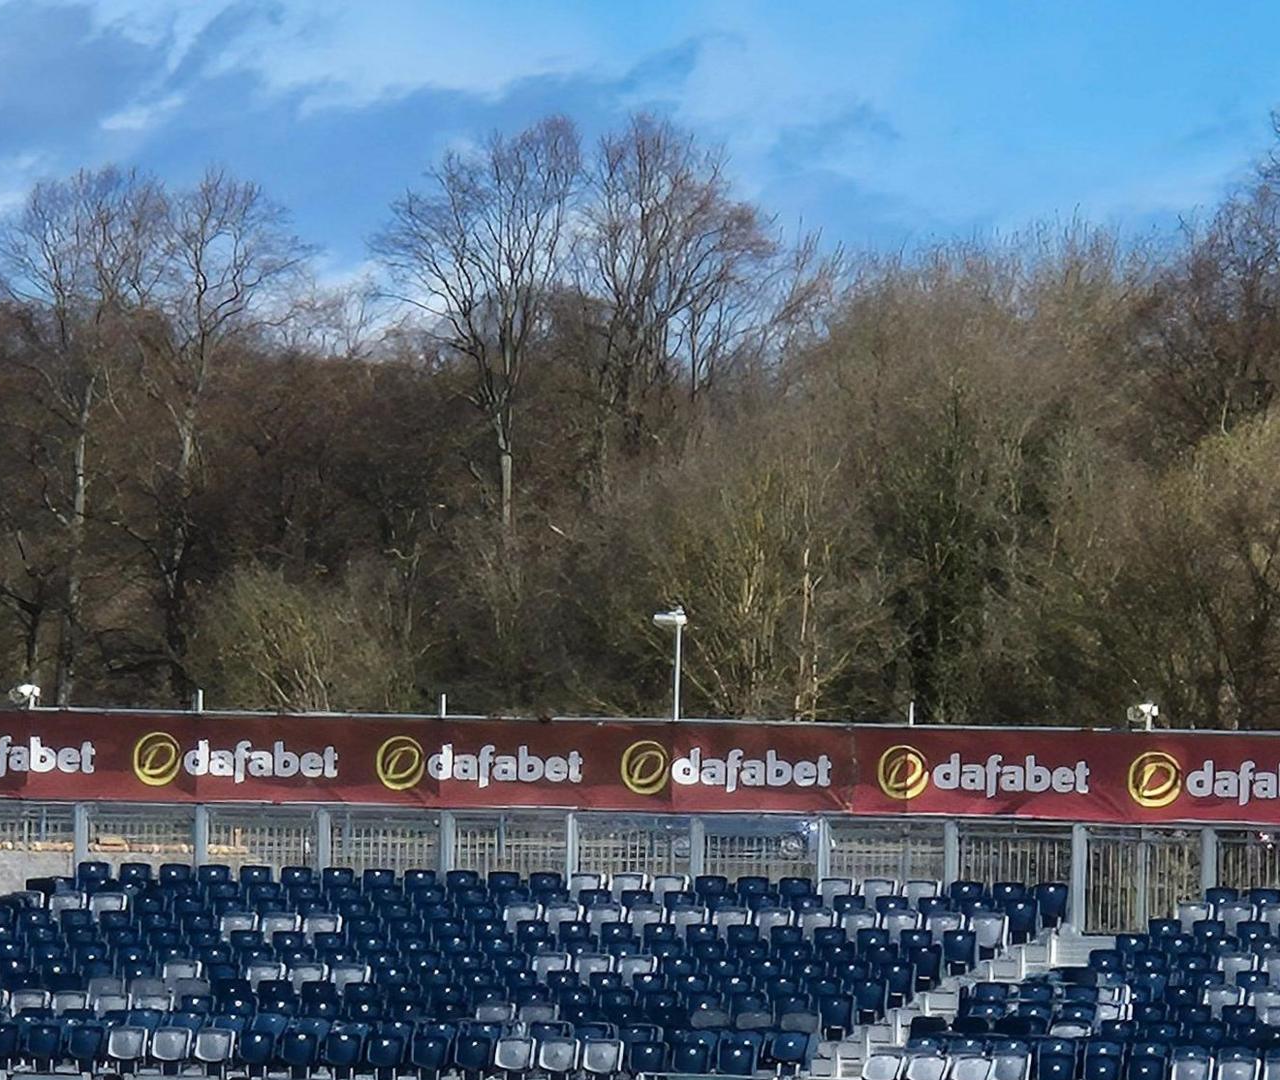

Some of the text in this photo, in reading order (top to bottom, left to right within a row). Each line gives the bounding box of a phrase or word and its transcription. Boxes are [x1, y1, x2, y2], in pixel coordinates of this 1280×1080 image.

[184, 740, 338, 784] dafabet
[428, 744, 583, 788] dafabet
[672, 747, 832, 793] dafabet
[932, 753, 1089, 798] dafabet
